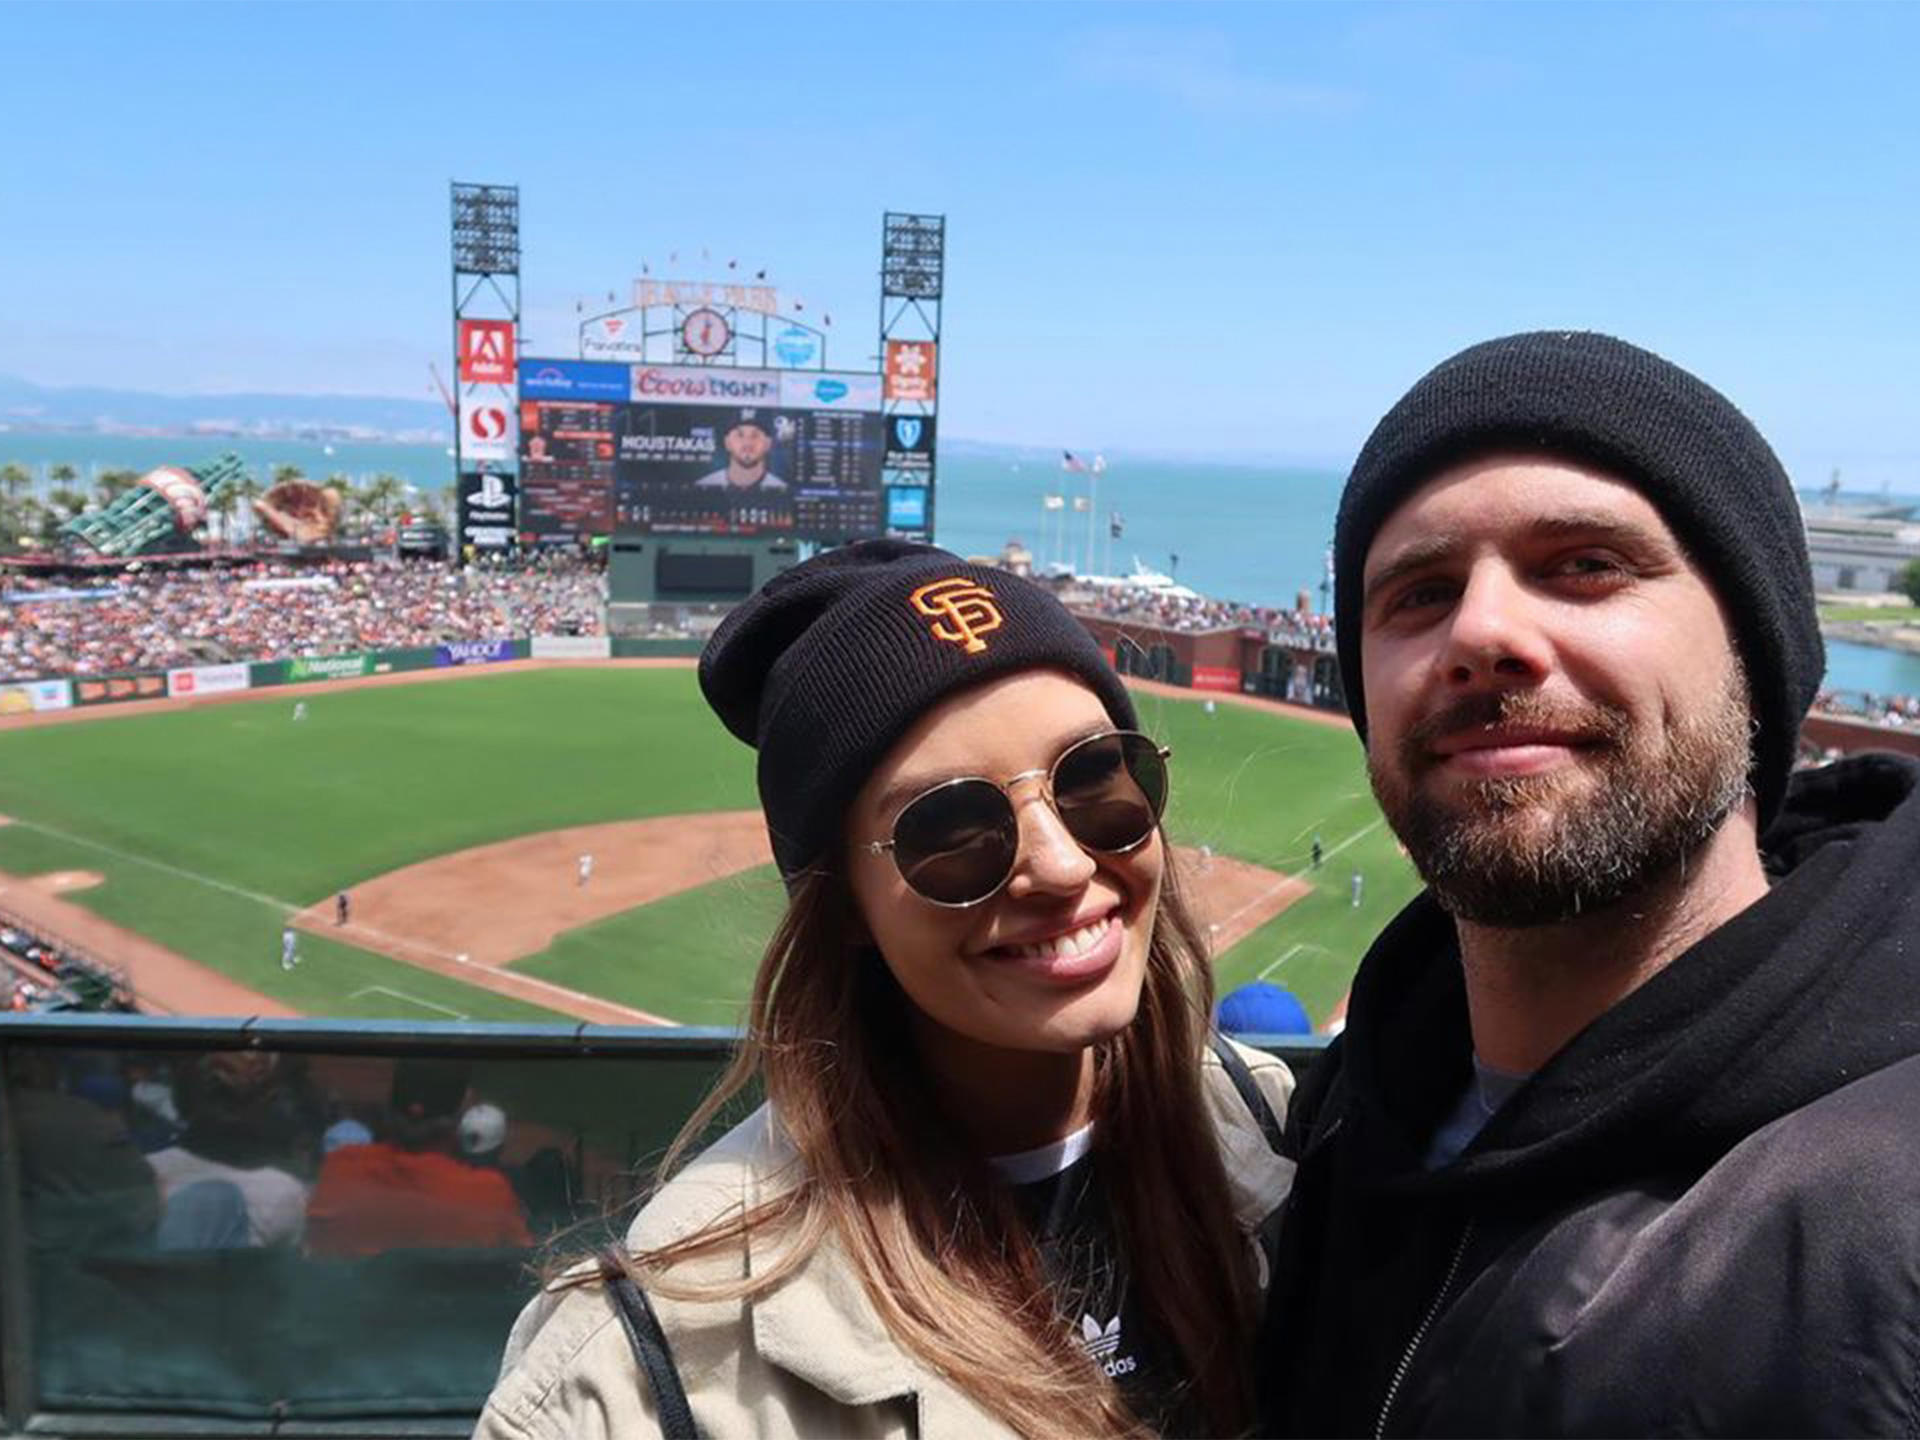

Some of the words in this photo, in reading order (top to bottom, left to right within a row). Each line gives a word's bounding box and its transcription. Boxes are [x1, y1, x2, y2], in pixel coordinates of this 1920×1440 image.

[637, 366, 706, 397] Coors
[708, 376, 769, 399] LIGHT
[621, 435, 716, 453] MOUSTAKAS
